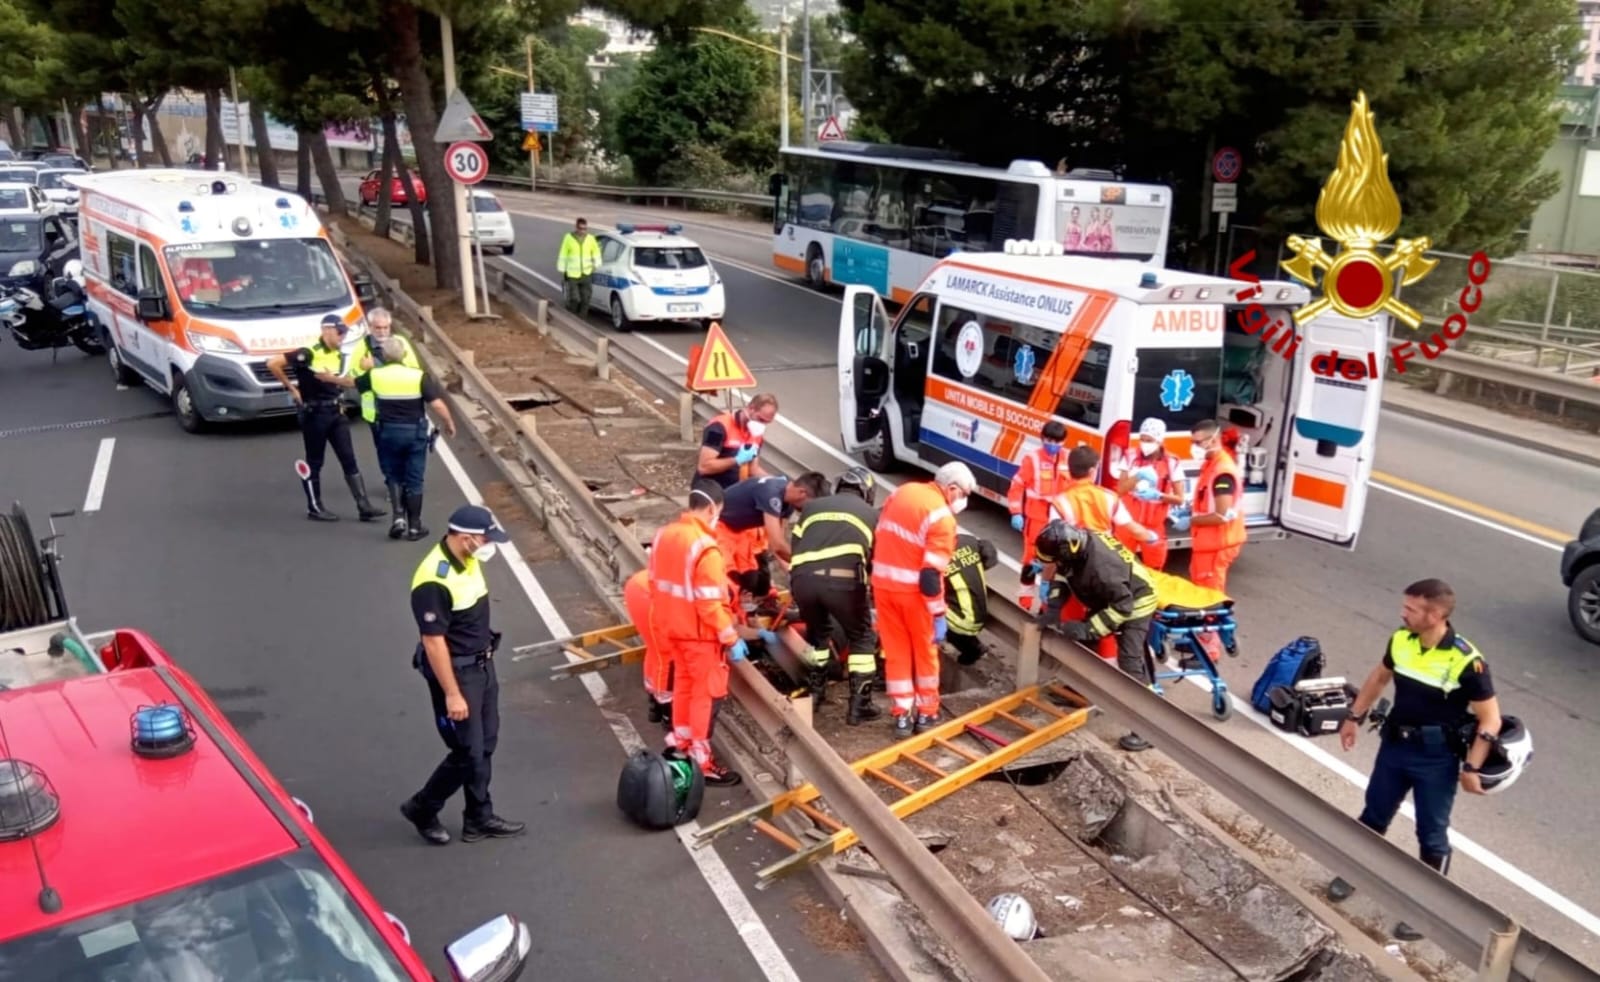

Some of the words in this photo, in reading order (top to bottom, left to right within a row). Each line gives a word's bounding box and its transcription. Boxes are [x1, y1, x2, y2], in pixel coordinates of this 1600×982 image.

[454, 153, 479, 172] 30
[946, 275, 989, 296] LAMARCK
[988, 283, 1036, 308] Assistance
[1037, 295, 1073, 315] ONLUS
